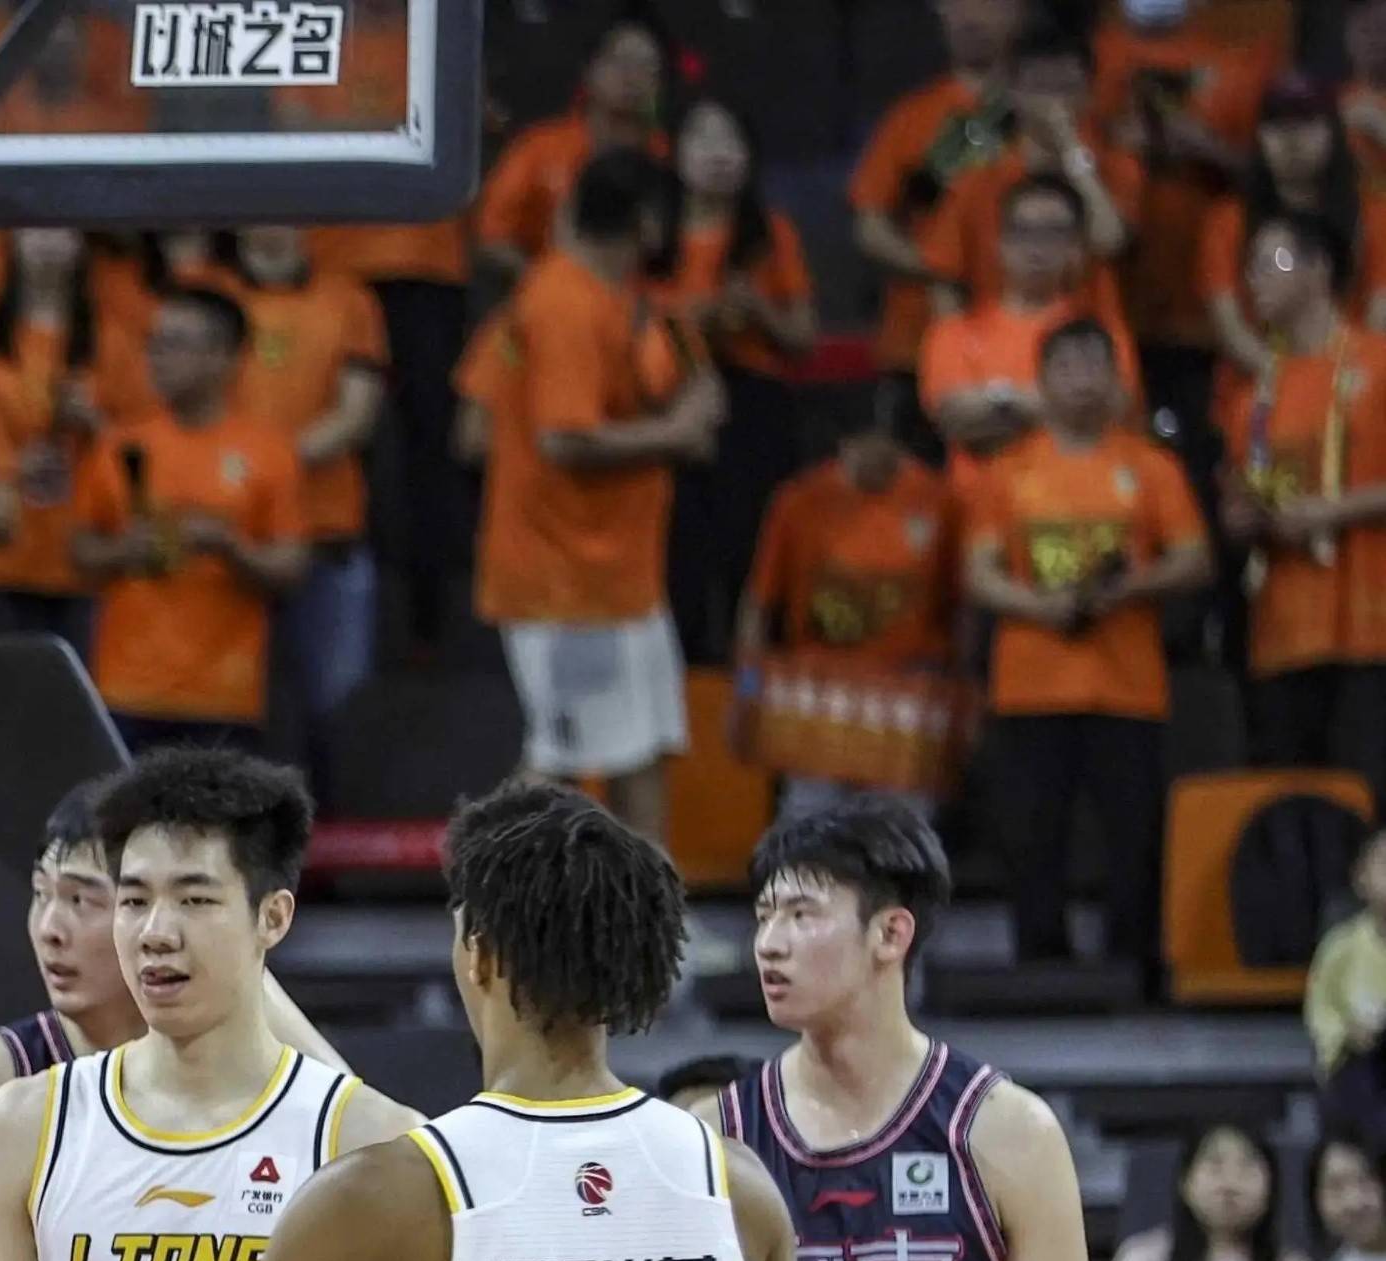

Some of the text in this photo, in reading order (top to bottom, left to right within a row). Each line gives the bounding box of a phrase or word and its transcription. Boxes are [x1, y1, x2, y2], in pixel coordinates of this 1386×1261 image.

[137, 5, 337, 78] 以城之名
[247, 1202, 273, 1214] CGB
